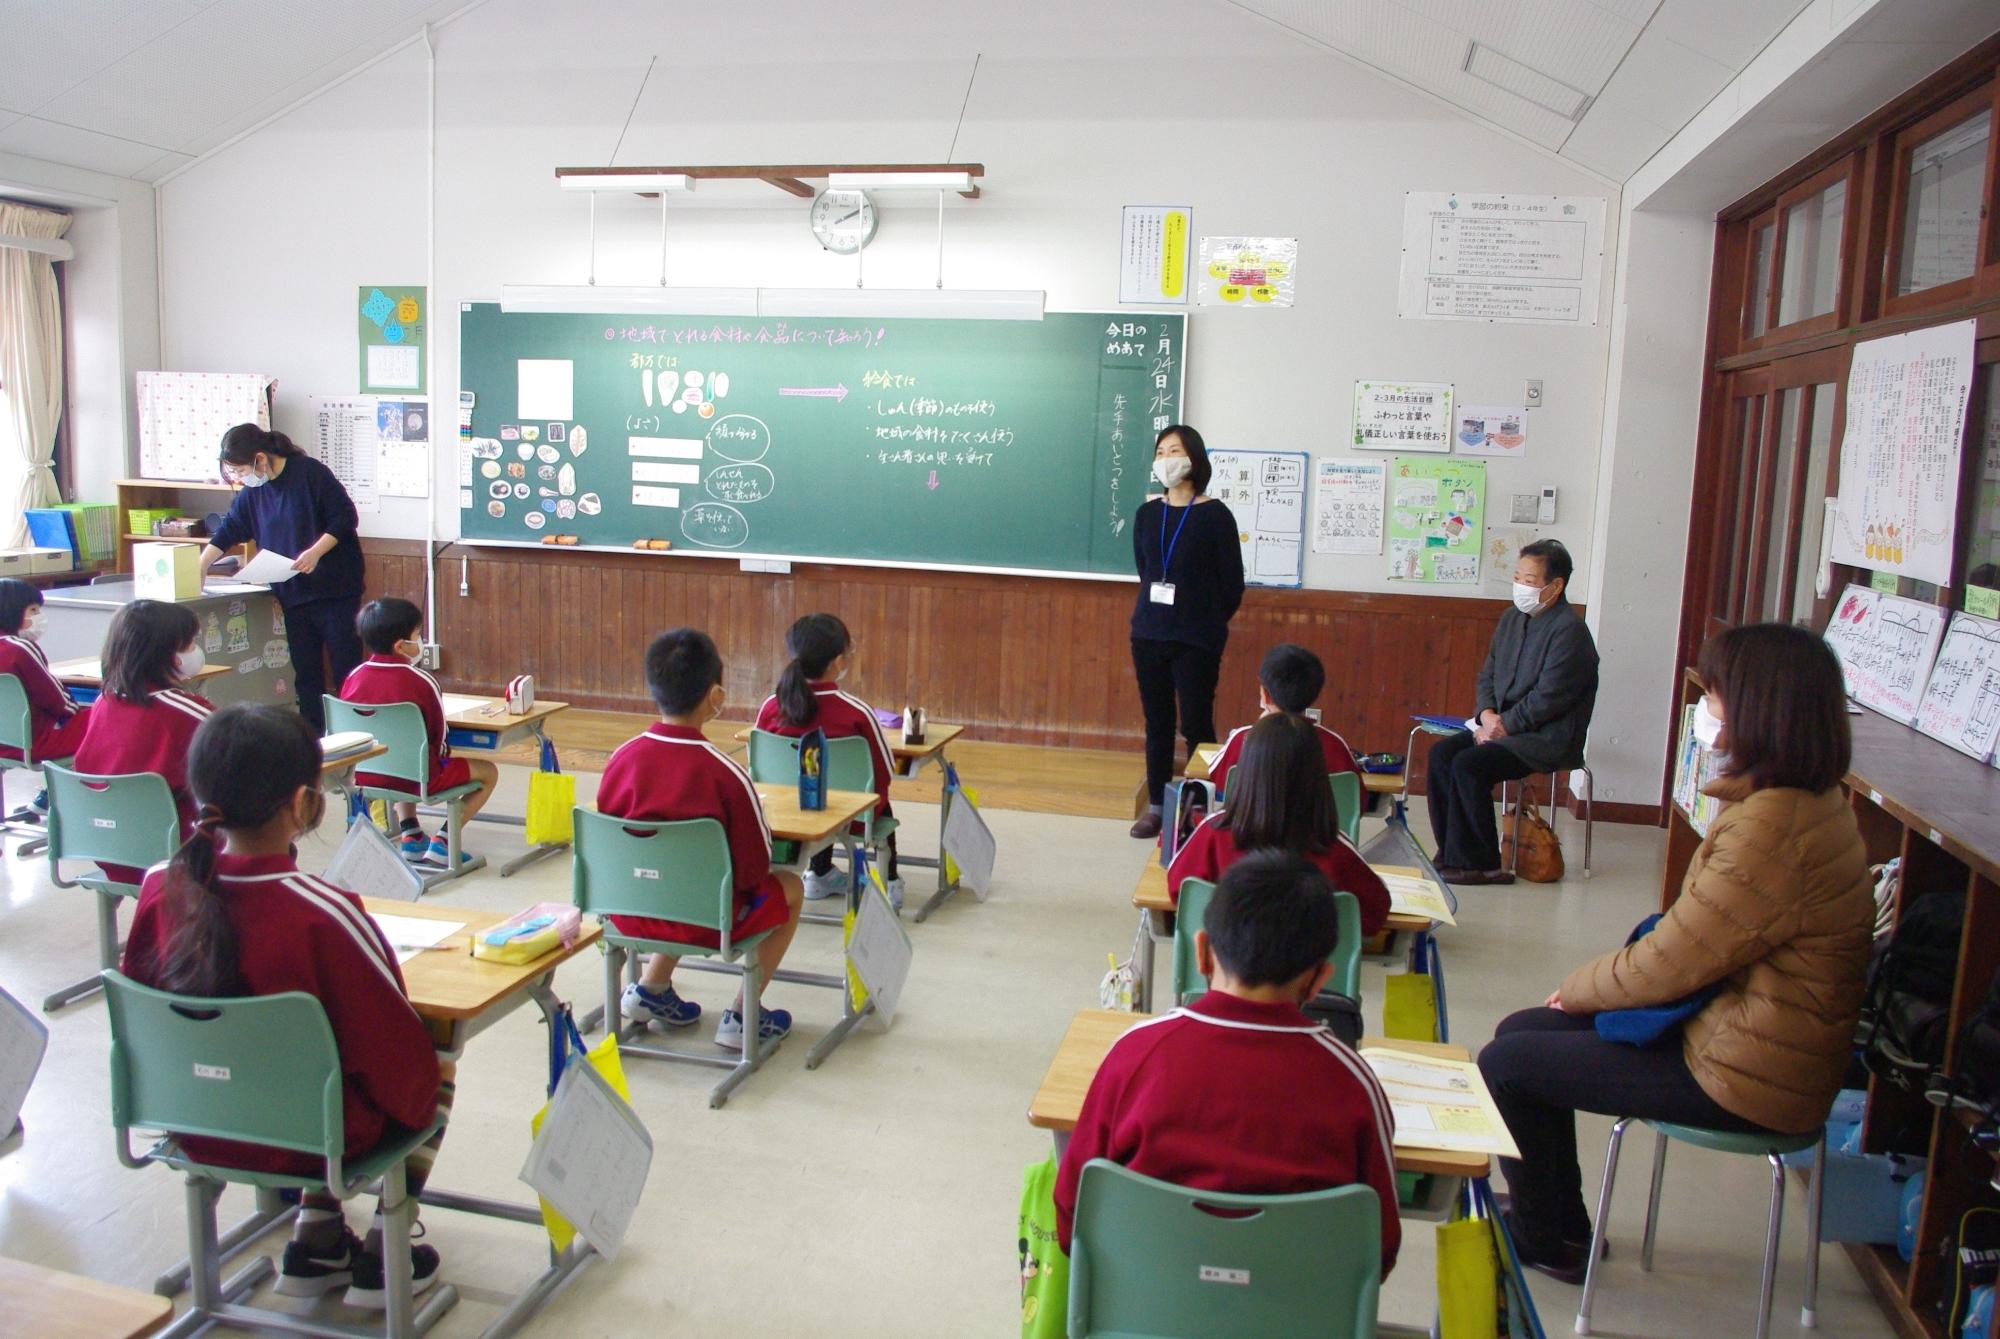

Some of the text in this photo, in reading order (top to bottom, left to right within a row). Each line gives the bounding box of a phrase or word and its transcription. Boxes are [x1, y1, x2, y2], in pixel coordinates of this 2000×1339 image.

[1105, 322, 1147, 338] 今日の
[1106, 341, 1145, 357] めあて
[1239, 489, 1250, 502] 外
